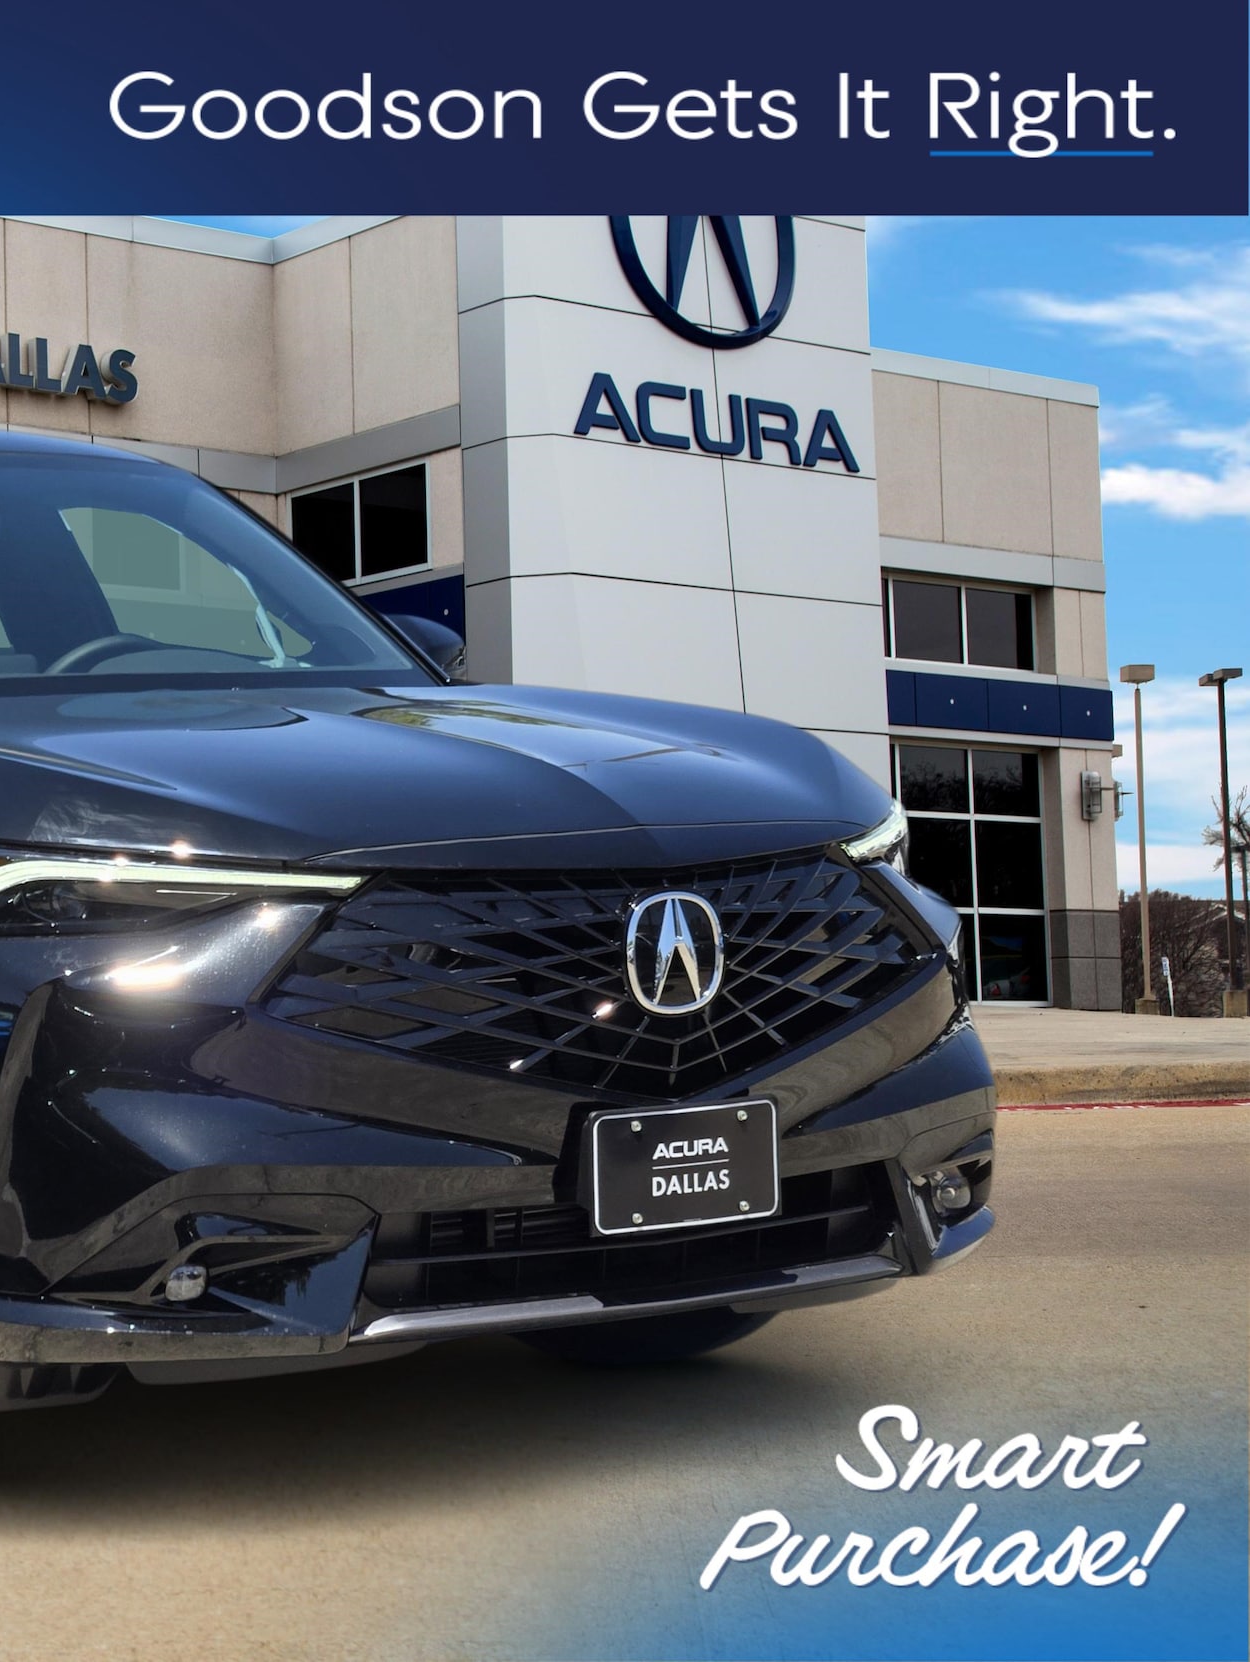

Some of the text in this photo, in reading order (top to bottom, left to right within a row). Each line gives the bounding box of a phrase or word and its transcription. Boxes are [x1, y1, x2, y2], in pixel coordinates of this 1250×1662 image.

[573, 372, 860, 473] ACURA
[652, 1137, 729, 1160] ACURA
[652, 1169, 730, 1197] DALLAS
